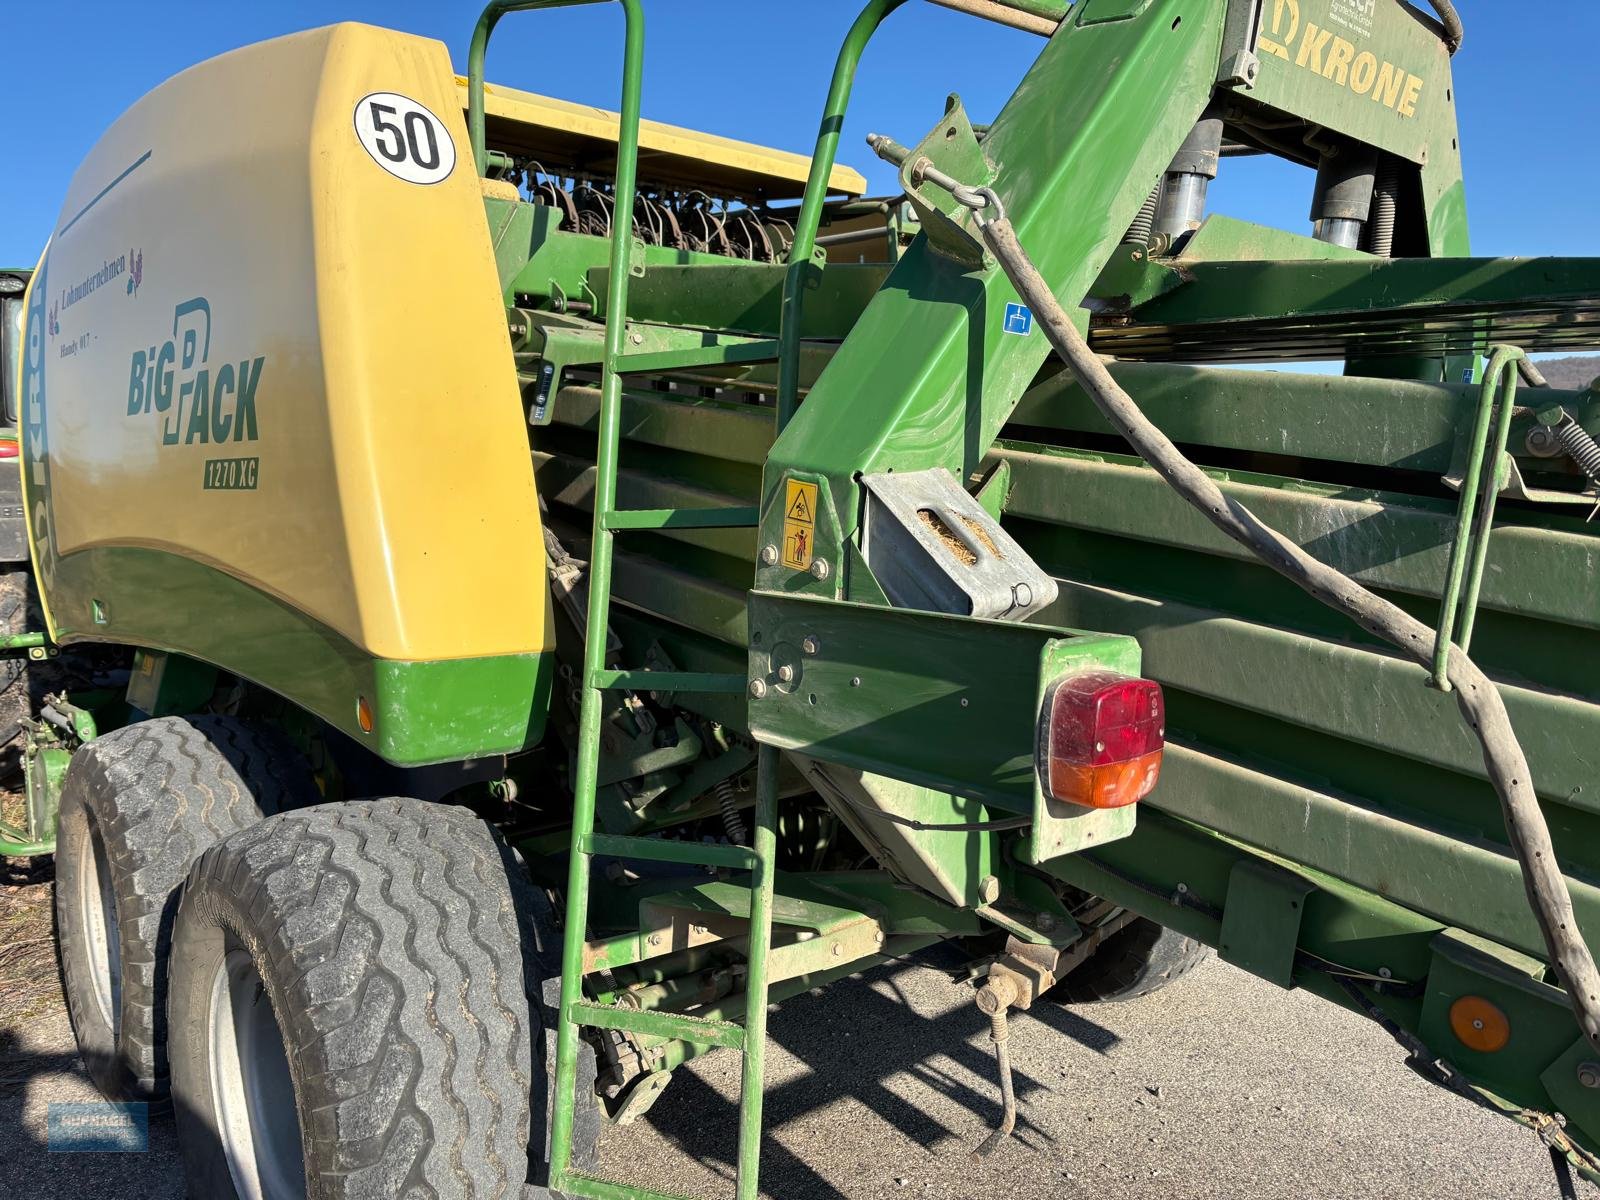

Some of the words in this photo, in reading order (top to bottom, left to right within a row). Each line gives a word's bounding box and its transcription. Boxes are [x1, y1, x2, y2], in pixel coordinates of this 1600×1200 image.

[1295, 22, 1423, 118] KRONE
[370, 101, 440, 170] 50
[62, 254, 126, 310] Lohnunternehmen
[209, 461, 236, 487] 1270
[239, 459, 256, 487] XC
